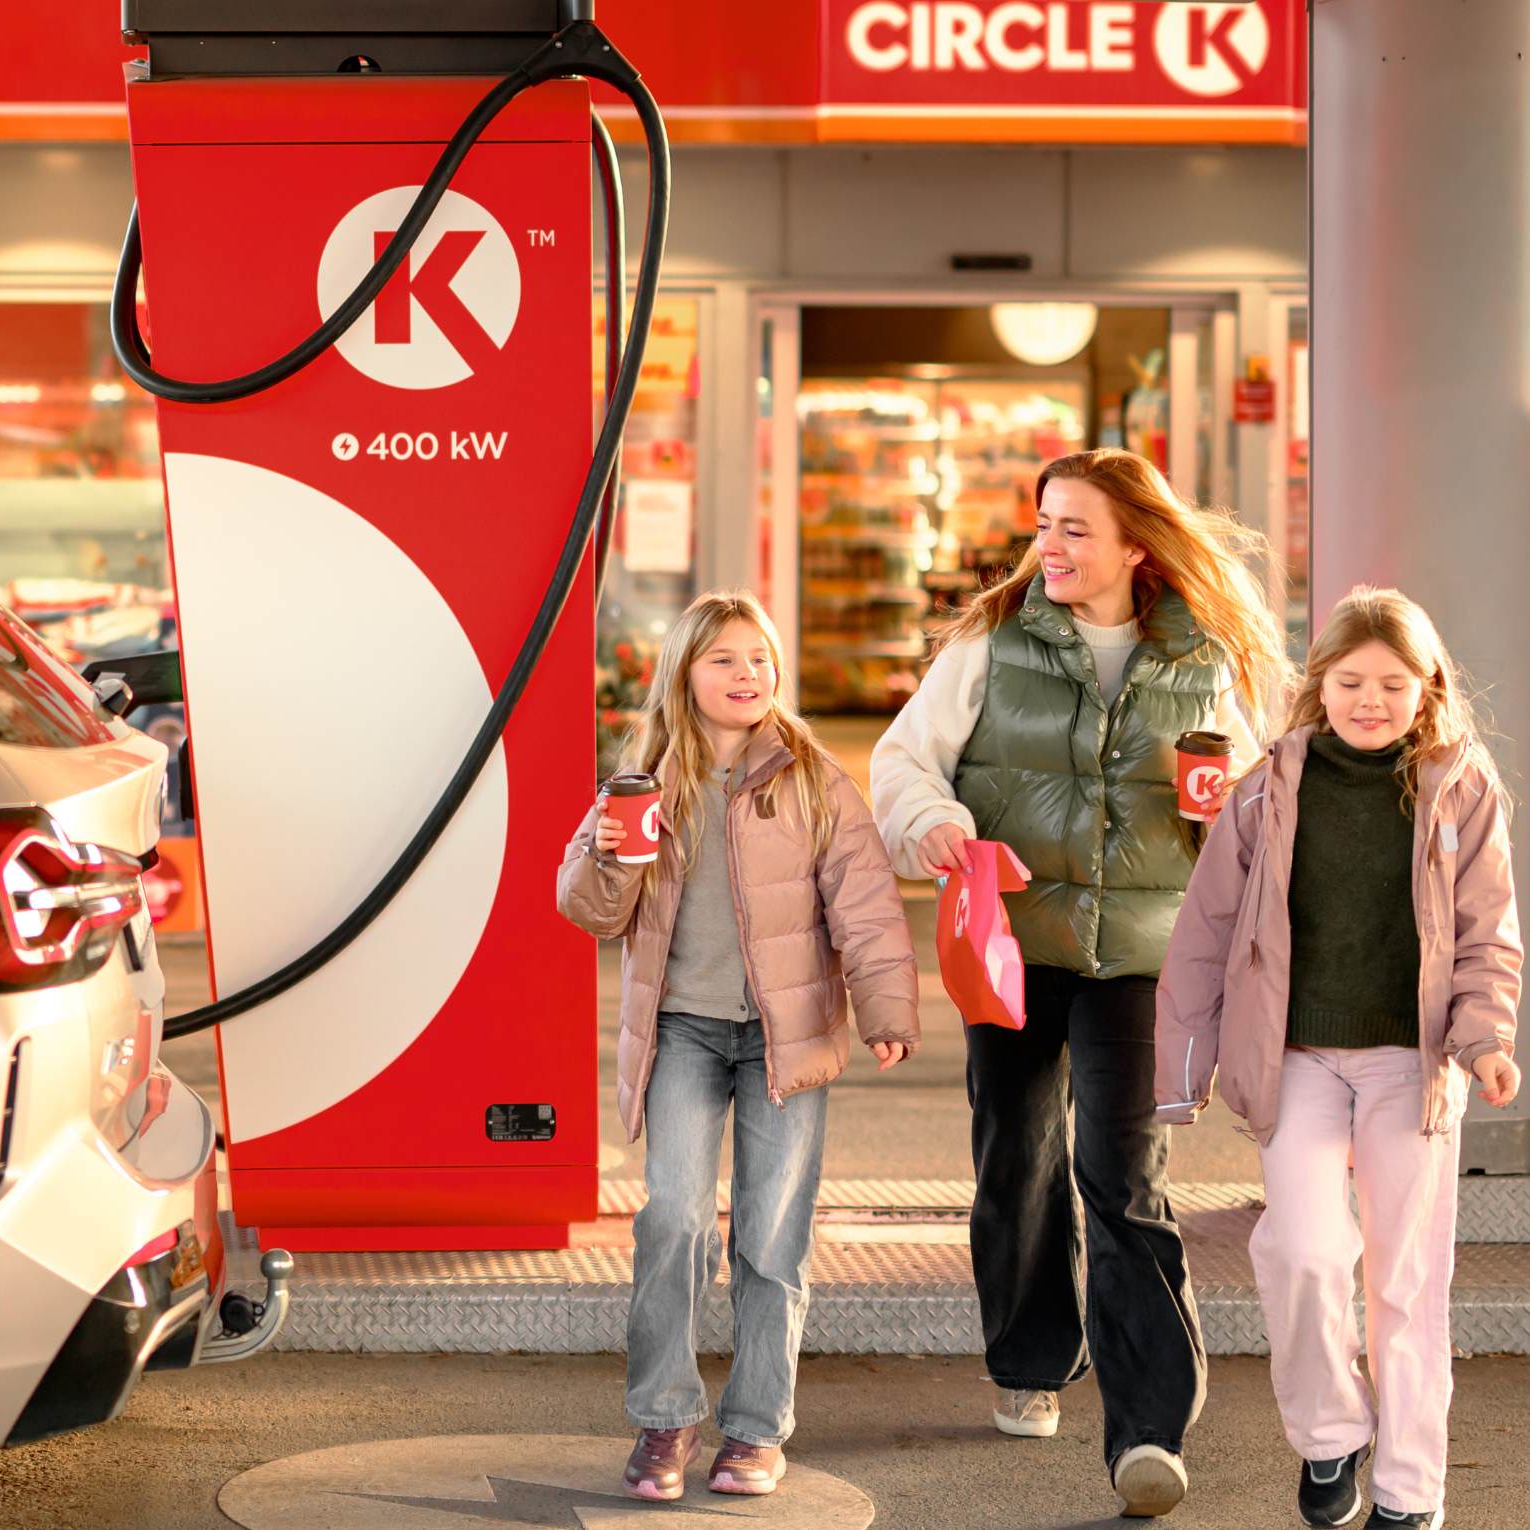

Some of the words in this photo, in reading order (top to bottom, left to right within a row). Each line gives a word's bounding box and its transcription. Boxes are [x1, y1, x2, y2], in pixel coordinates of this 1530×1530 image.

[846, 1, 1135, 71] CIRCLE
[366, 431, 439, 461] 400
[450, 431, 509, 461] kW
